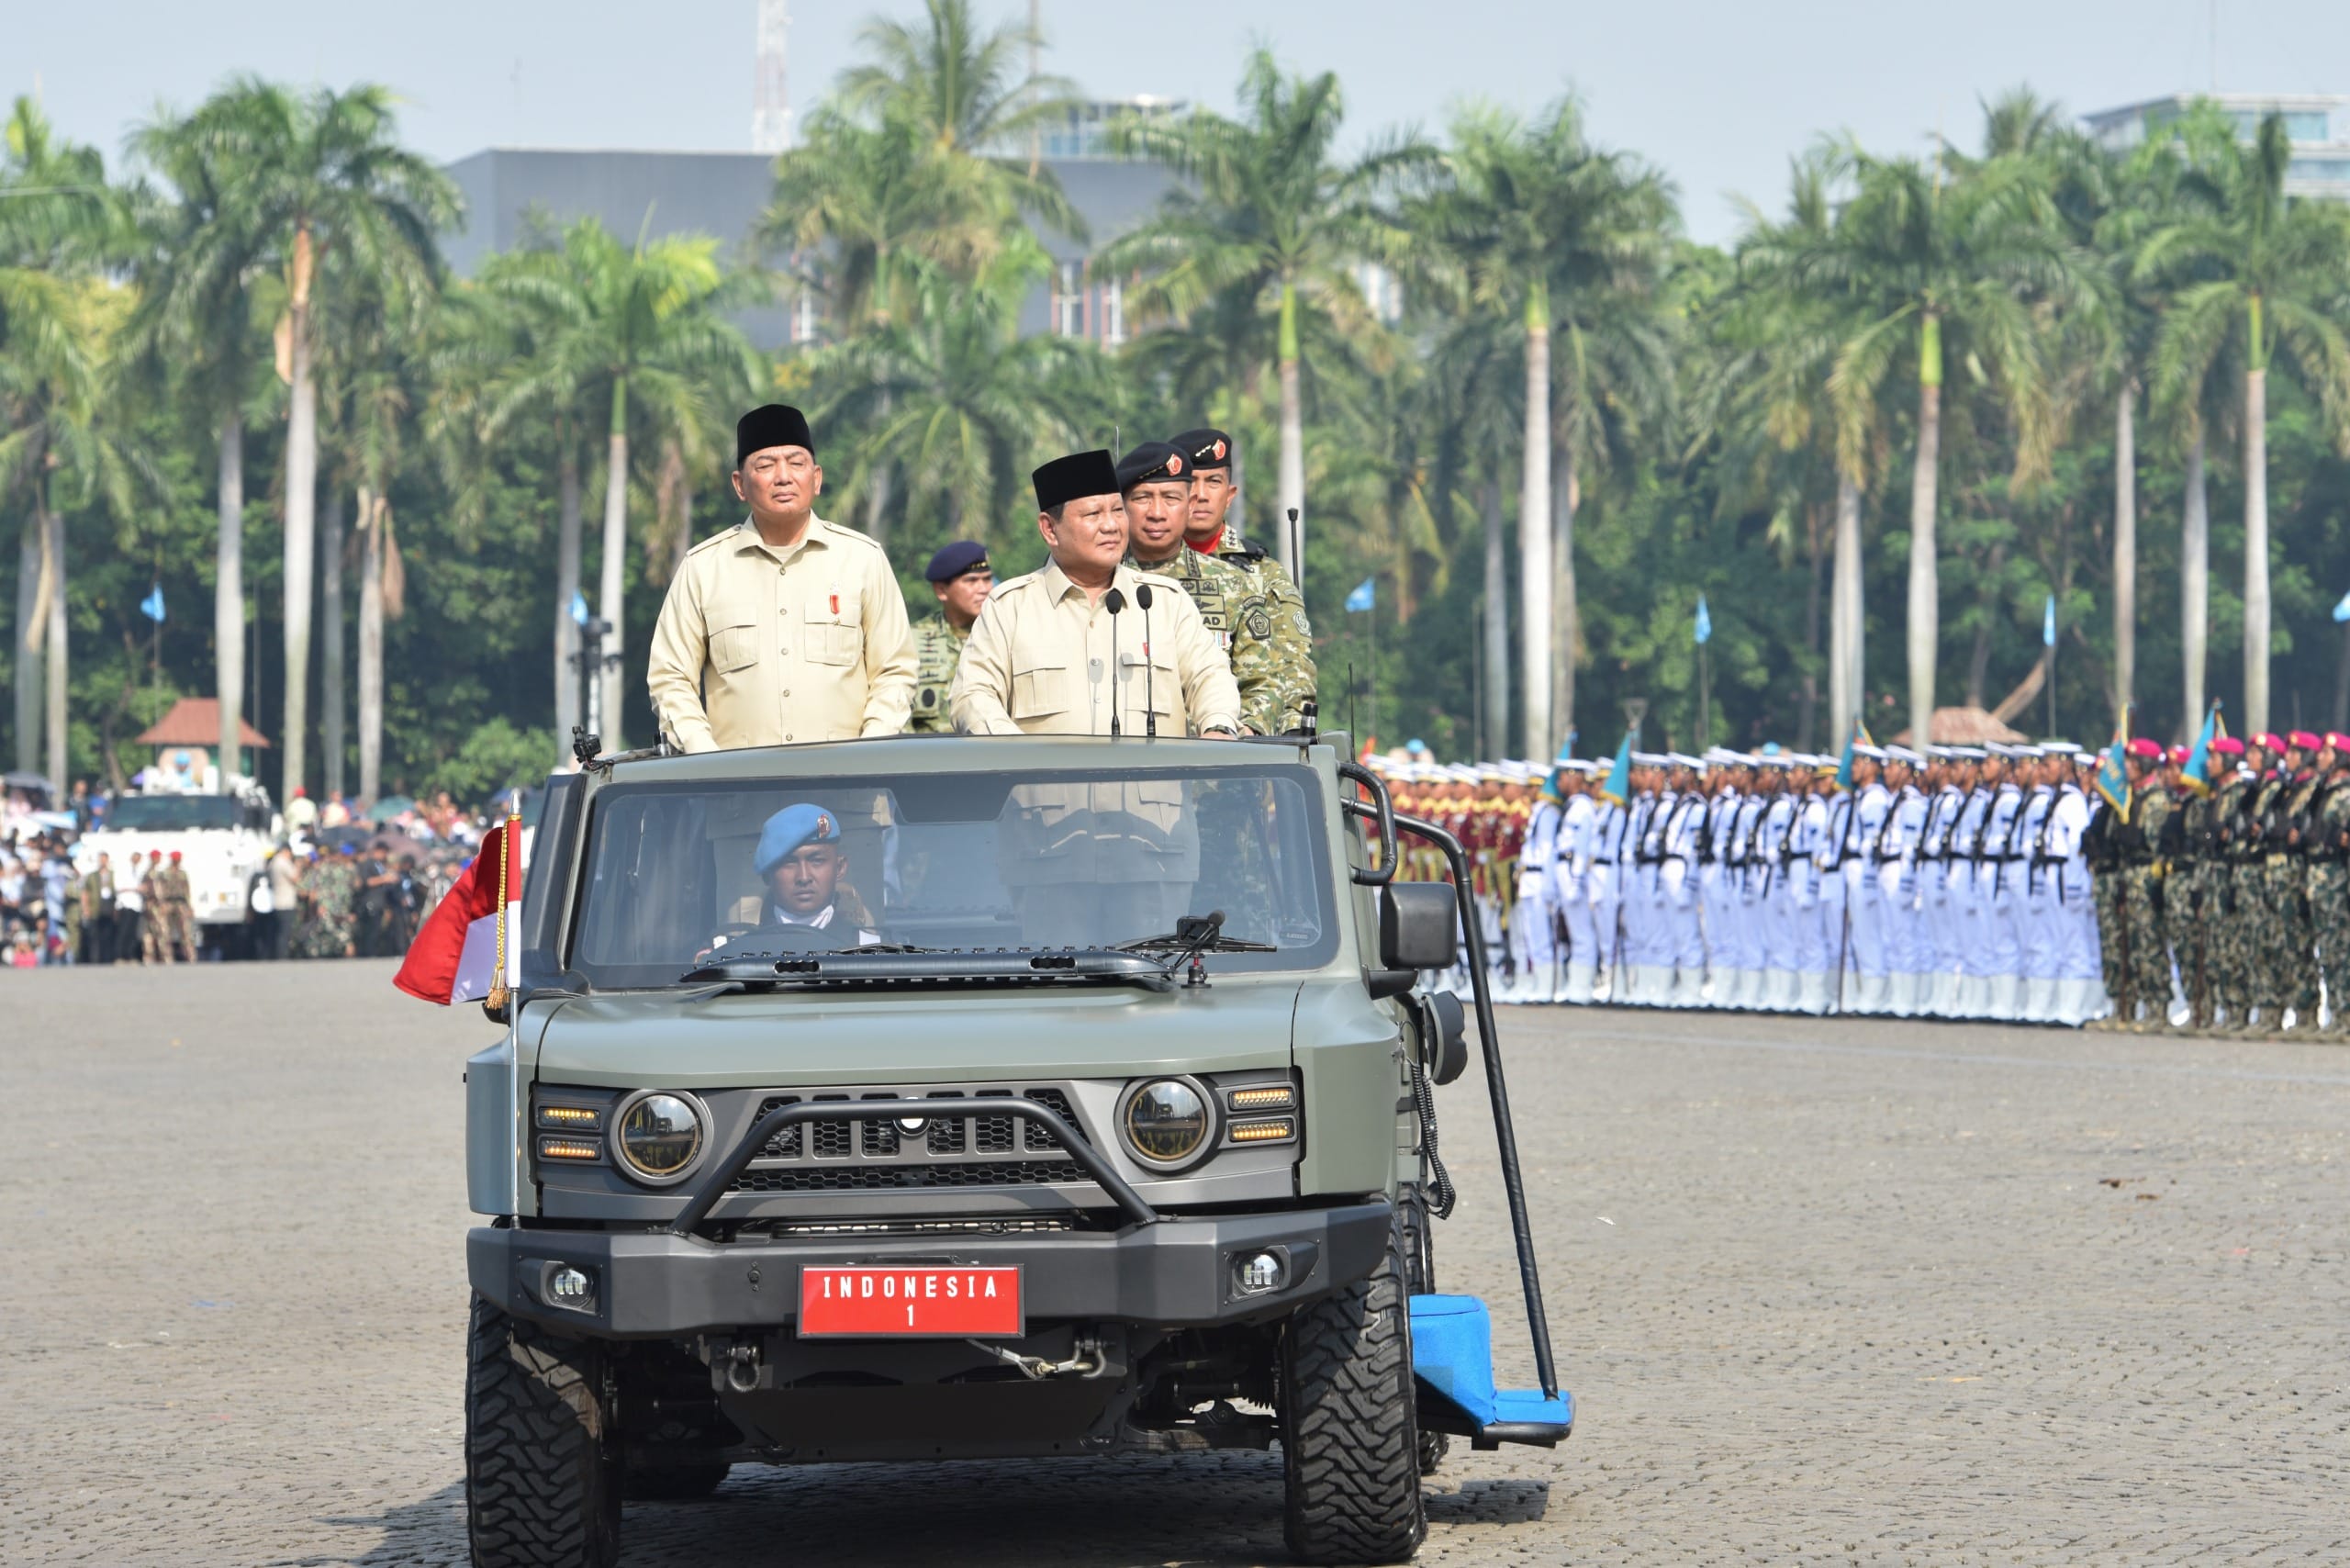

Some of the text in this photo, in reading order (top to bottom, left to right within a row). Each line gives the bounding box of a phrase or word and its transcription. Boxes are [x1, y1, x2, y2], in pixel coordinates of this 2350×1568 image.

[1203, 616, 1220, 626] AD
[823, 1276, 997, 1298] INDONESIA
[906, 1305, 914, 1327] 1
